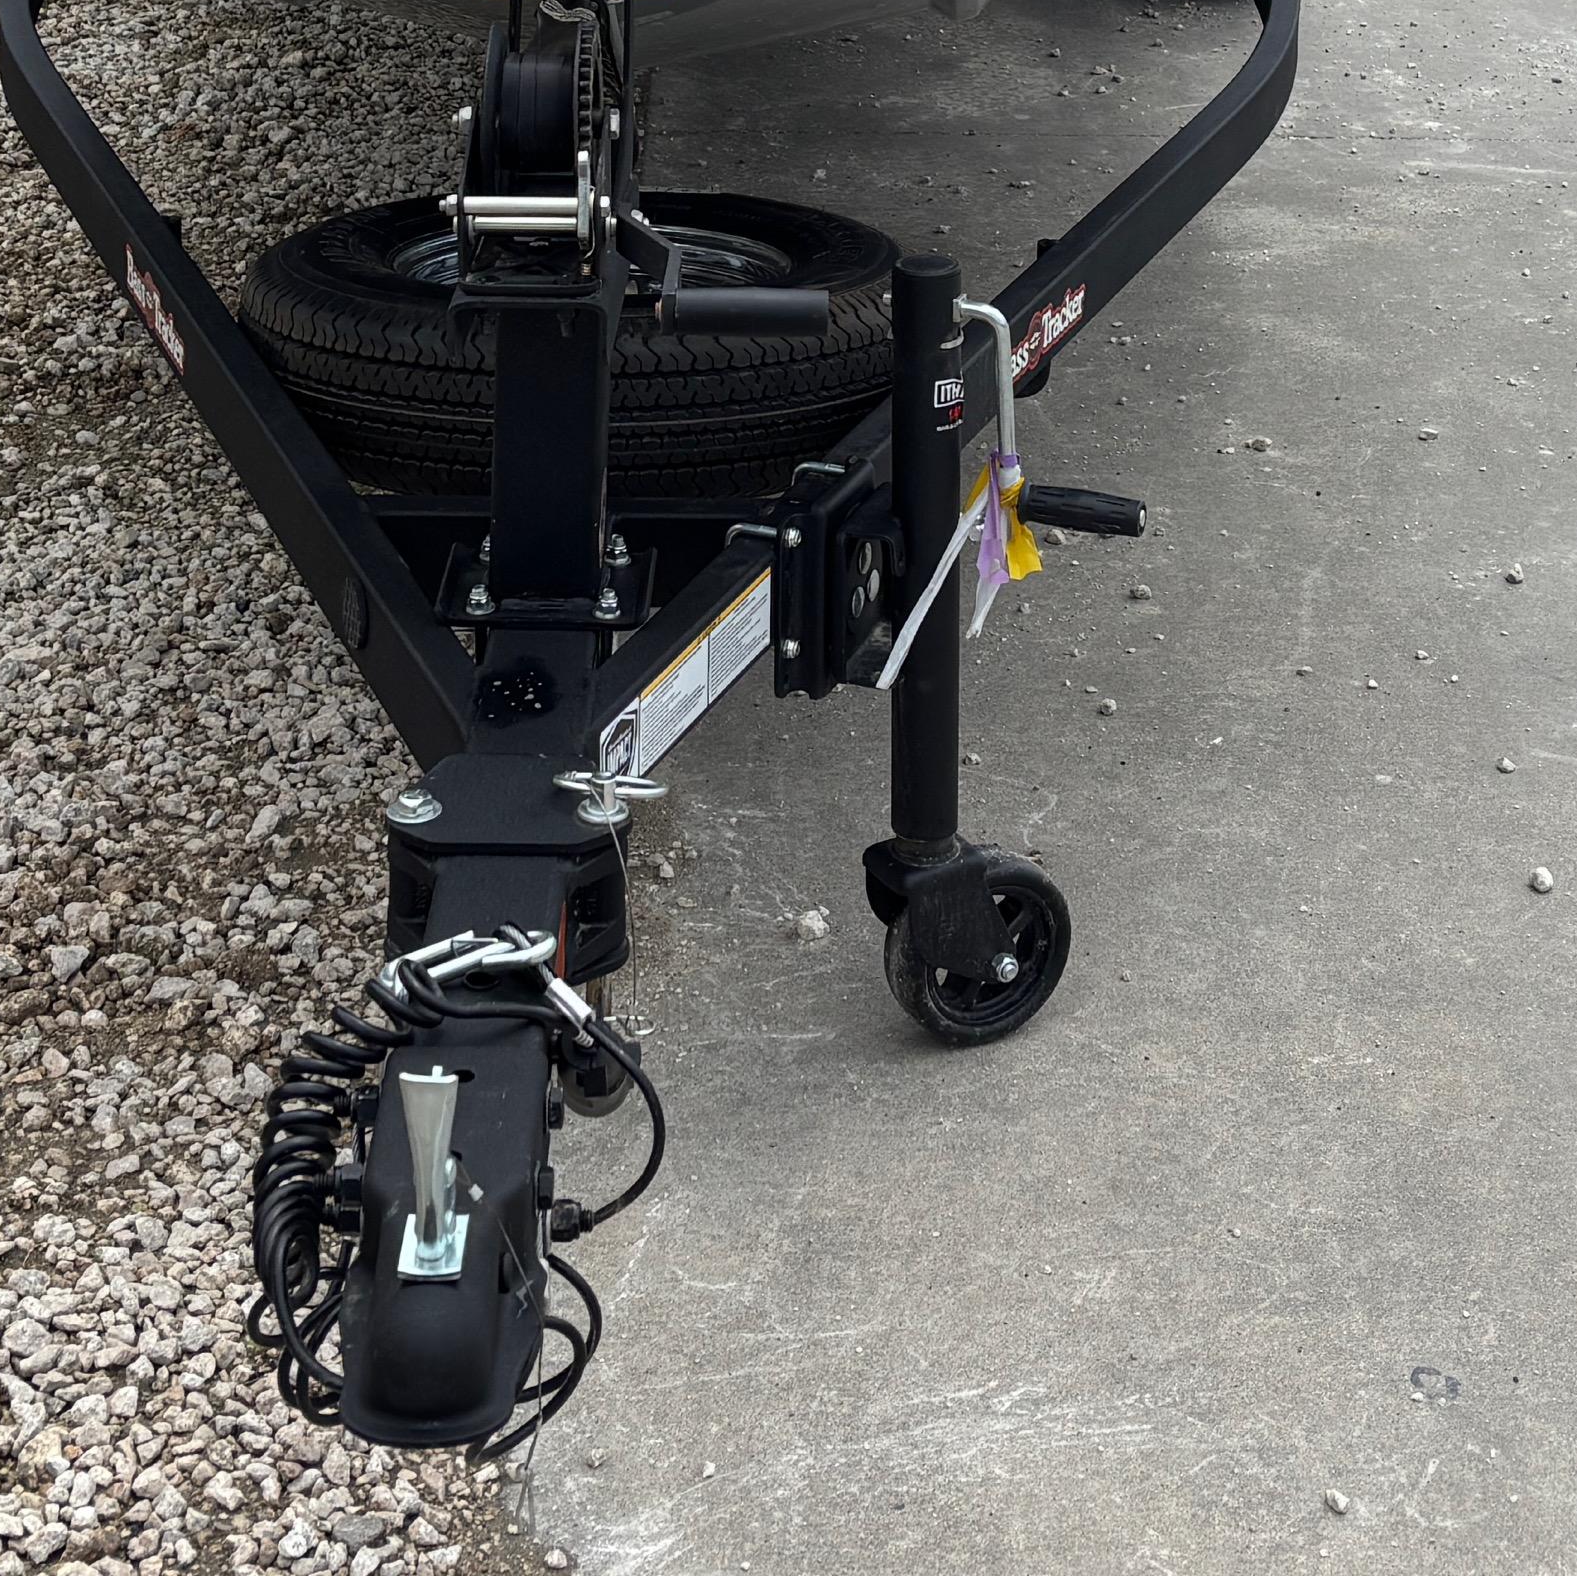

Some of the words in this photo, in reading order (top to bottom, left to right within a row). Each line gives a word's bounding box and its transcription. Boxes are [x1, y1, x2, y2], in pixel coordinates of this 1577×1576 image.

[126, 249, 146, 309] Bass
[152, 290, 184, 369] Tracker
[1010, 342, 1029, 377] ass
[1041, 289, 1085, 348] Tracker
